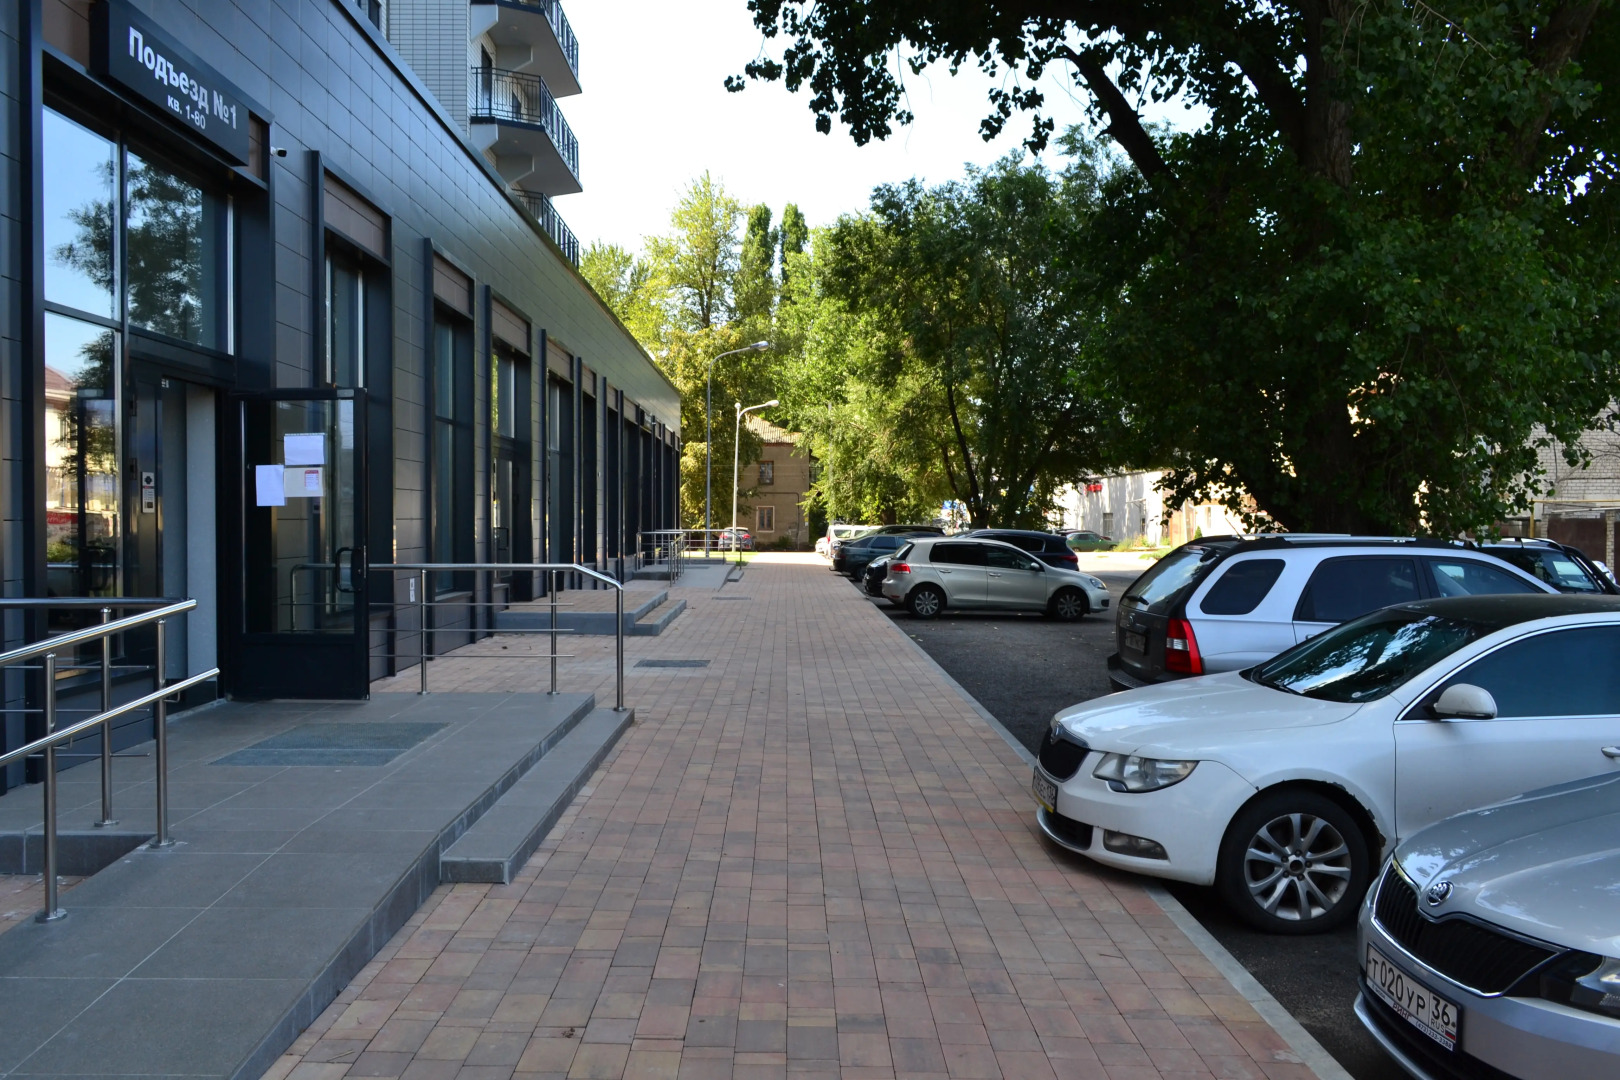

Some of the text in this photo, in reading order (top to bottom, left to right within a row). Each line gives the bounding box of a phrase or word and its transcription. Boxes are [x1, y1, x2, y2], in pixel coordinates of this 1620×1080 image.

[129, 26, 237, 130] Подъезд №1
[167, 95, 206, 130] кв. 1-80
[1371, 957, 1451, 1027] Т020УР 36
[1430, 1019, 1445, 1034] RUS
